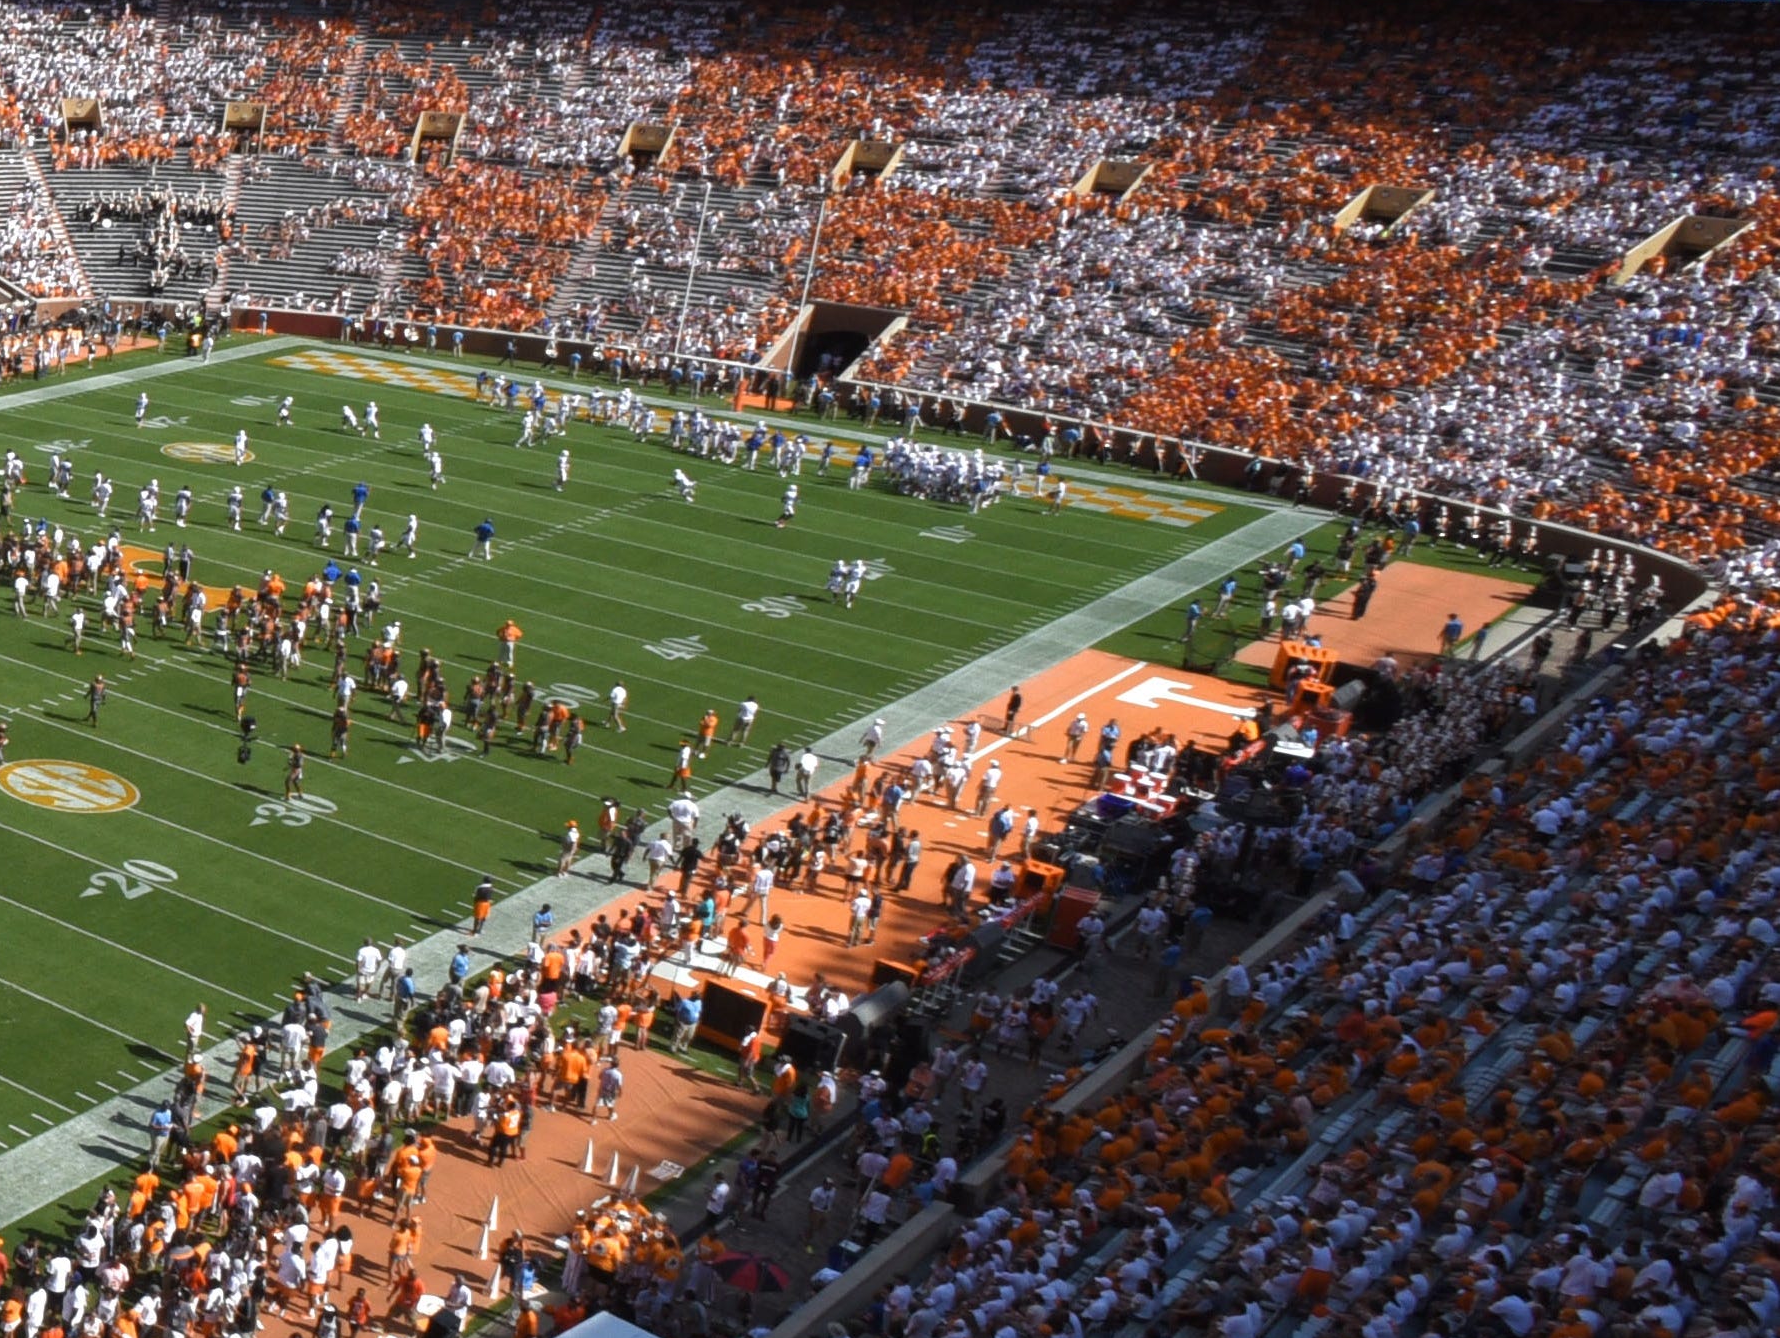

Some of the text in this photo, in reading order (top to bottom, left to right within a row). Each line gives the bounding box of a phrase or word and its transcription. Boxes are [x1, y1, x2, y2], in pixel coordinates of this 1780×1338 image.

[741, 596, 808, 619] 30
[642, 636, 710, 661] 40
[255, 791, 338, 828] 30
[89, 859, 179, 901] 20
